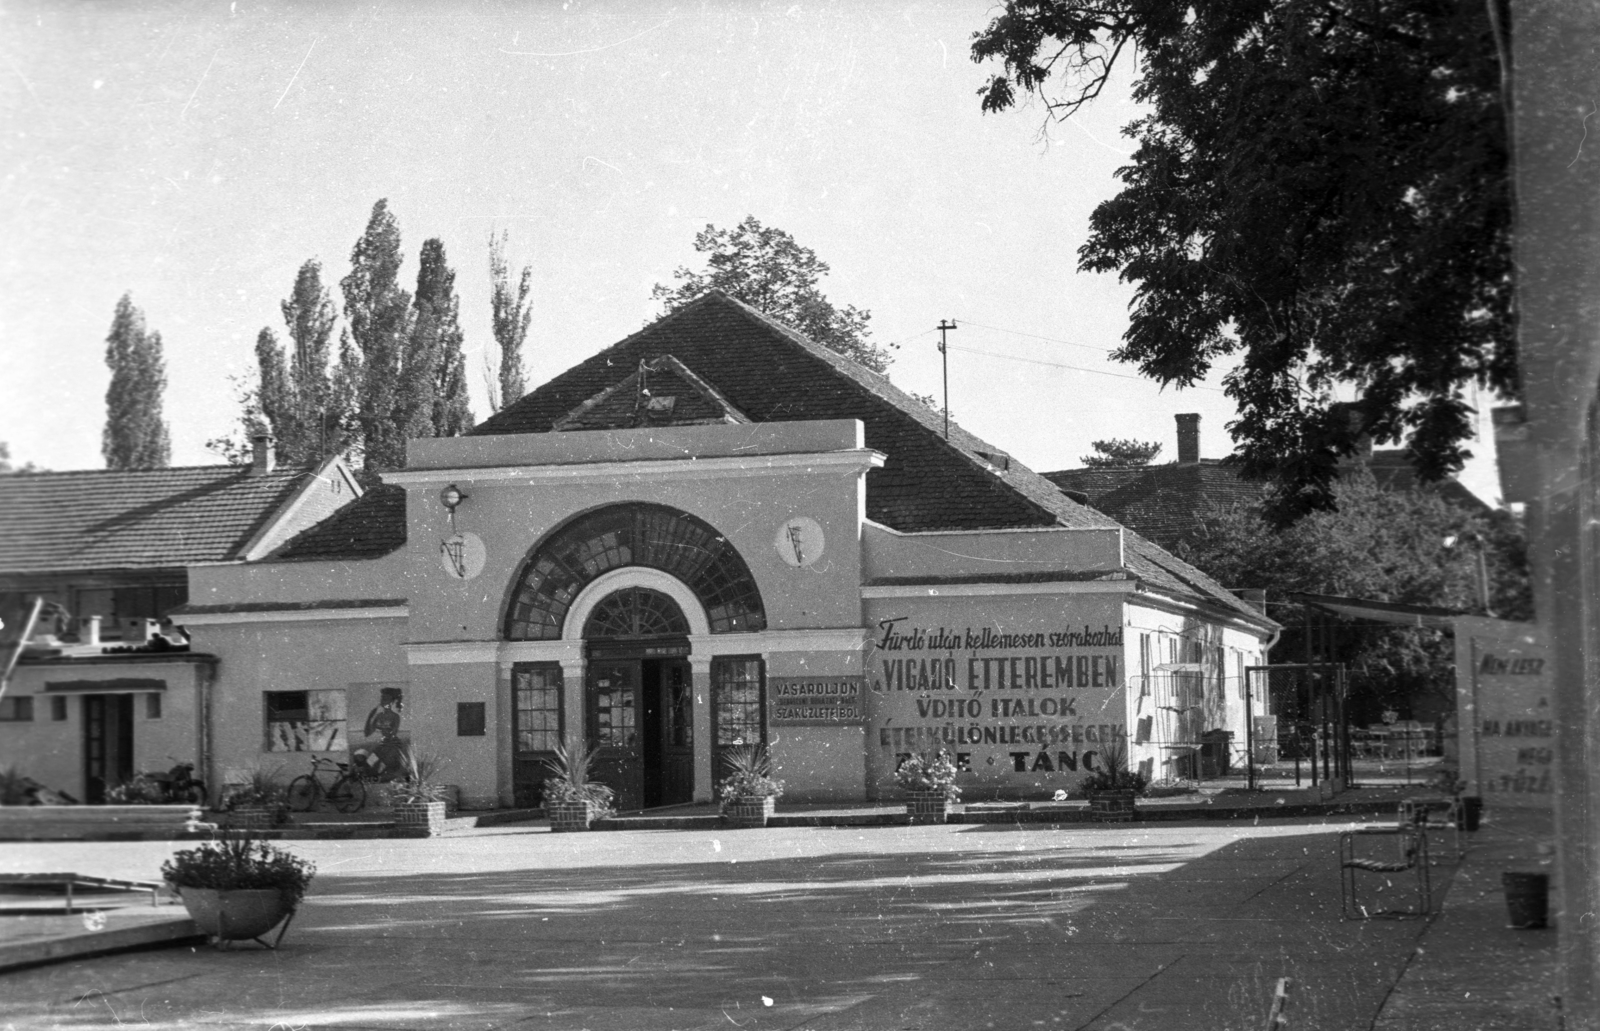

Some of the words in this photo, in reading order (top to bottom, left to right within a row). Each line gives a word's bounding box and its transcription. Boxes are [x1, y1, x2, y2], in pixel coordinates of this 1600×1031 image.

[875, 616, 926, 650] Fürdő
[928, 627, 962, 650] után
[964, 627, 1045, 650] kellemesen
[1048, 624, 1124, 648] szórakozhat
[873, 679, 882, 692] A
[882, 651, 956, 691] VIGADÓ
[967, 650, 1117, 690] ÉTTEREMBEN
[776, 682, 860, 696] VÁSÁROLJON
[991, 697, 1077, 717] ITALOK
[1009, 743, 1101, 773] TÁNC
